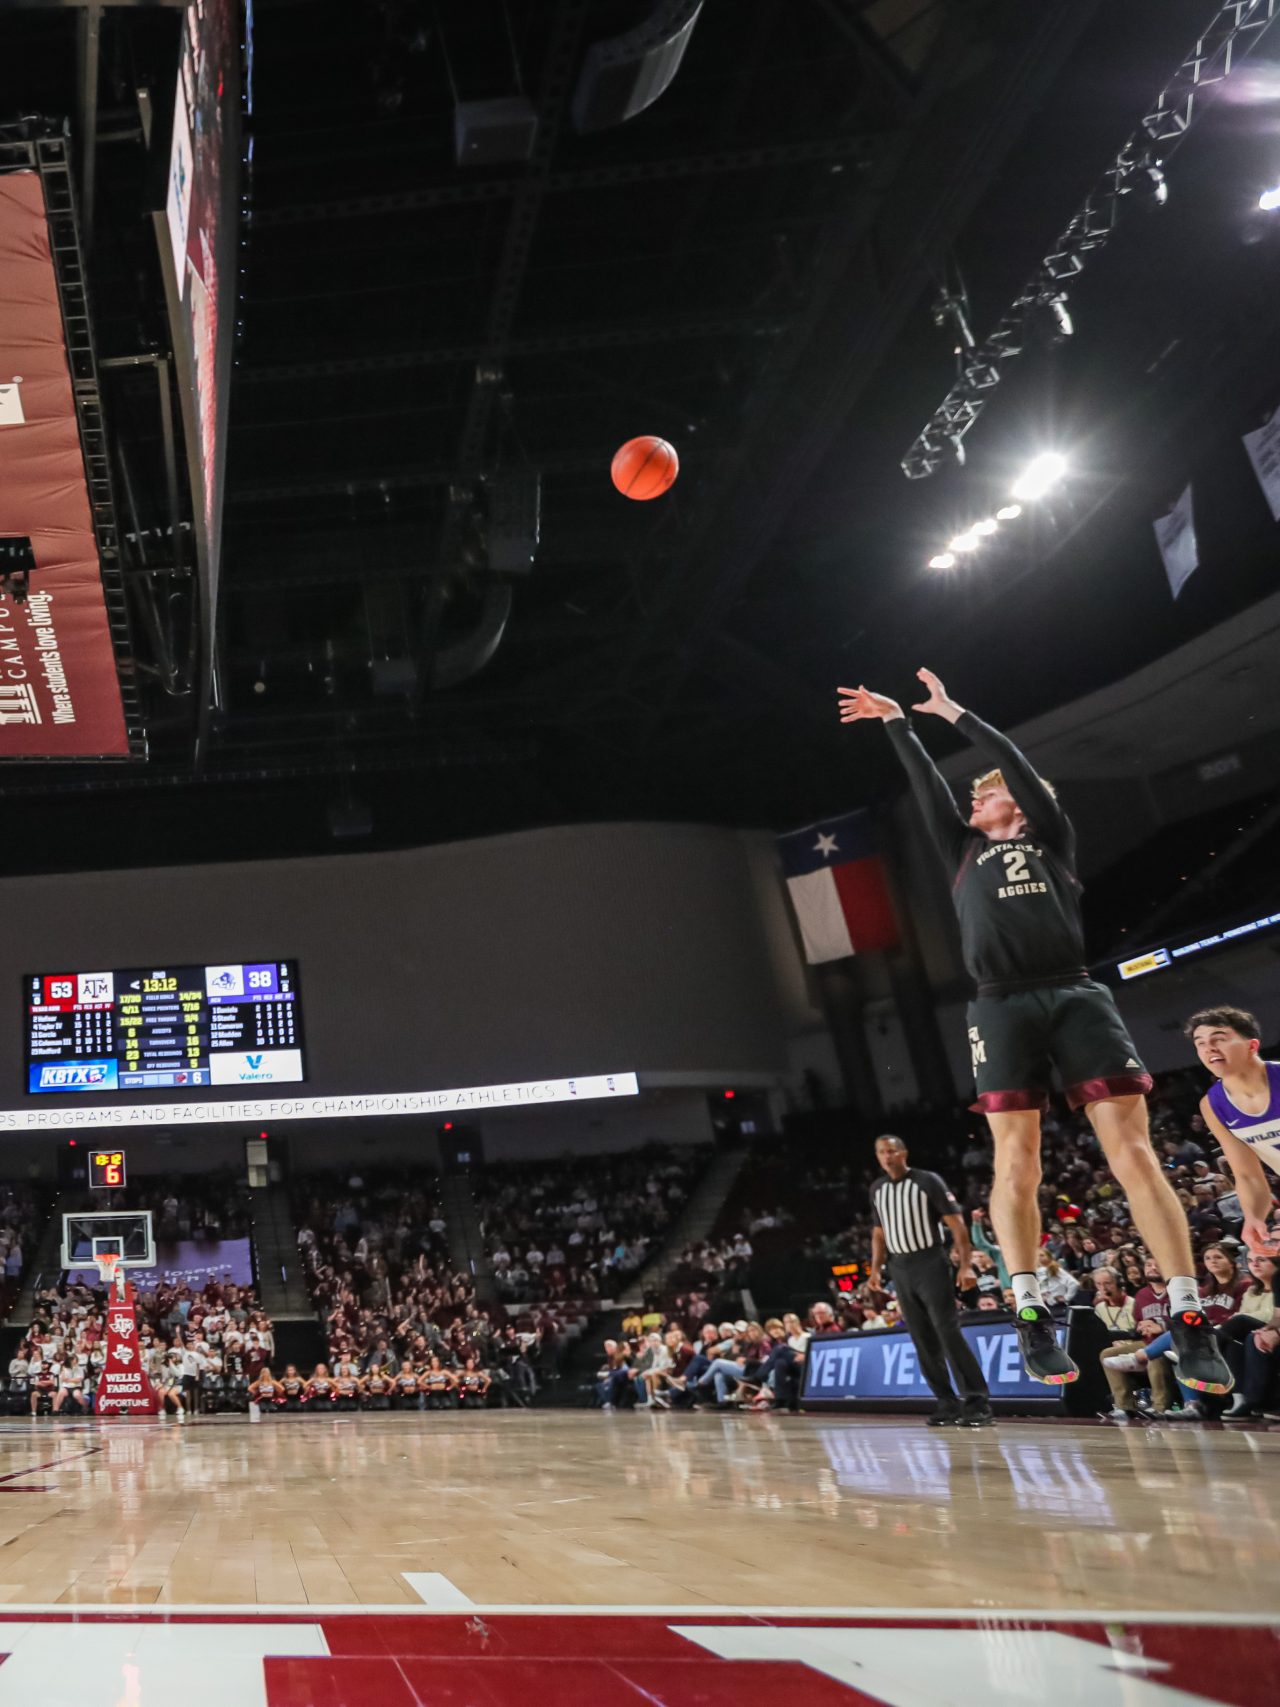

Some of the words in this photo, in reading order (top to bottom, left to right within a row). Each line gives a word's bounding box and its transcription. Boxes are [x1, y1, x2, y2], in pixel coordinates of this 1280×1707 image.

[34, 627, 59, 651] love
[38, 651, 69, 694] students
[51, 694, 77, 725] Where
[1003, 850, 1030, 882] 2
[998, 882, 1047, 899] AGGIES
[143, 978, 177, 992] 13:12
[248, 971, 272, 988] 38
[51, 981, 73, 998] 53
[44, 1067, 88, 1084] KBTX
[192, 1072, 202, 1084] 6
[238, 1070, 274, 1080] Valero
[27, 1110, 123, 1126] PROGRAMS
[130, 1108, 166, 1121] AND
[173, 1104, 264, 1119] FACILITIES
[270, 1102, 306, 1115] FOR
[312, 1096, 449, 1114] CHAMPIONSHIP
[455, 1084, 556, 1106] ATHLETICS
[106, 1164, 121, 1184] 6
[809, 1346, 861, 1388] YETI
[105, 1373, 141, 1383] WELLS
[106, 1384, 142, 1393] FARGO
